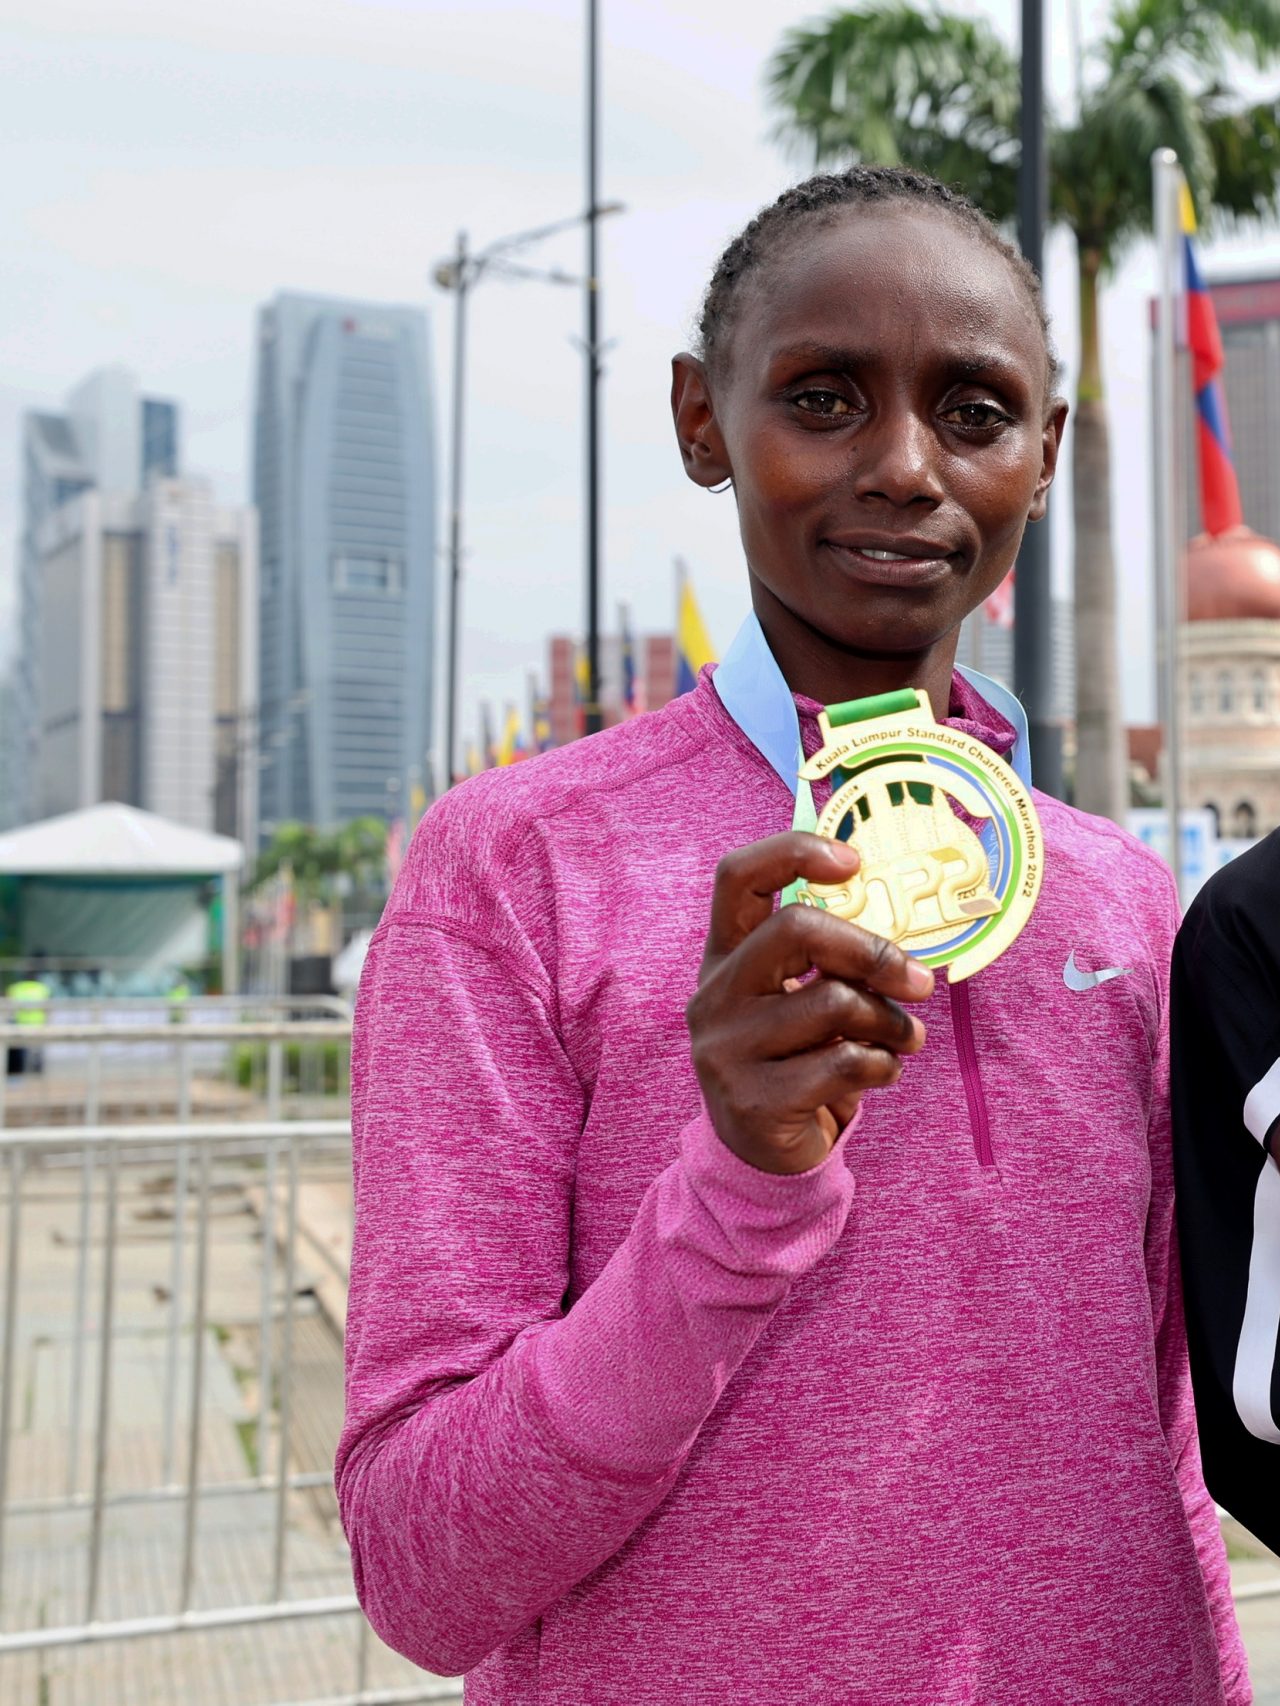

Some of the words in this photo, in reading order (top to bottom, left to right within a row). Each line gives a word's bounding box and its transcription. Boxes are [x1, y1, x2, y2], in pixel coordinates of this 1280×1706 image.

[852, 729, 902, 747] Lumpur
[907, 727, 966, 750] Standard
[816, 744, 850, 770] Kuala
[968, 746, 1019, 797] Chartered
[1015, 798, 1036, 860] Marathon
[1022, 864, 1037, 898] 2022
